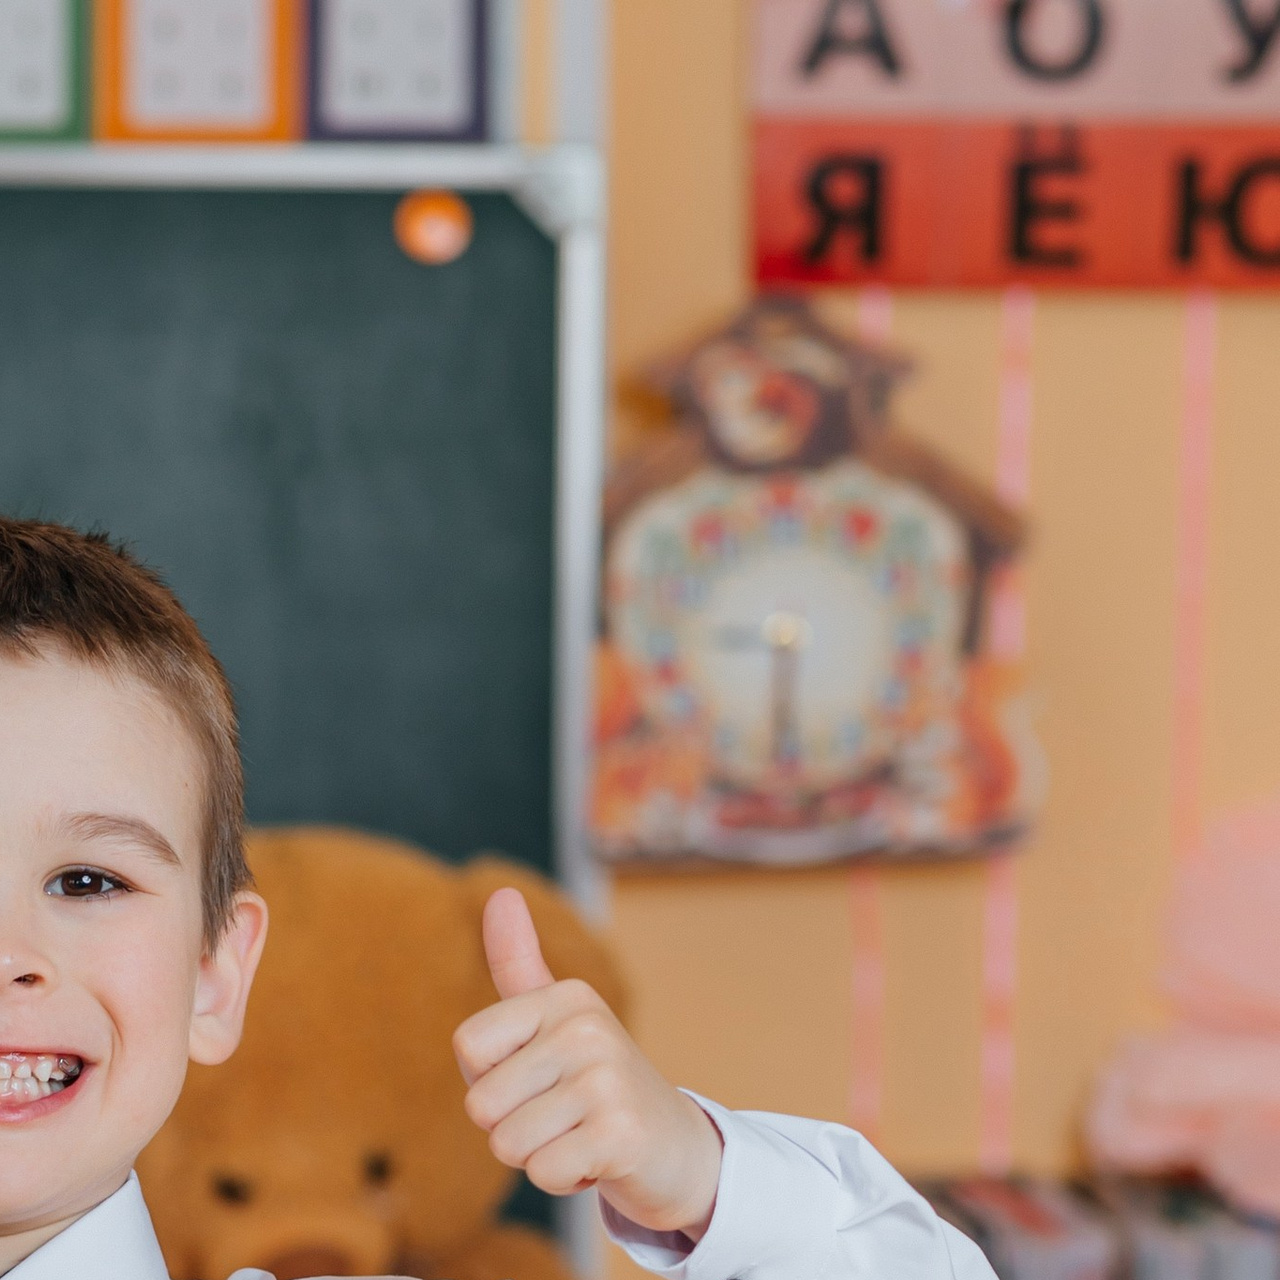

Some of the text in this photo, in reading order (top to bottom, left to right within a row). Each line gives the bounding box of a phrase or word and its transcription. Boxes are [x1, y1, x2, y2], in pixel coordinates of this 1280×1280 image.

[796, 0, 903, 83] А
[1005, 0, 1106, 82] О
[803, 152, 885, 267] Я
[1009, 122, 1086, 268] Ё
